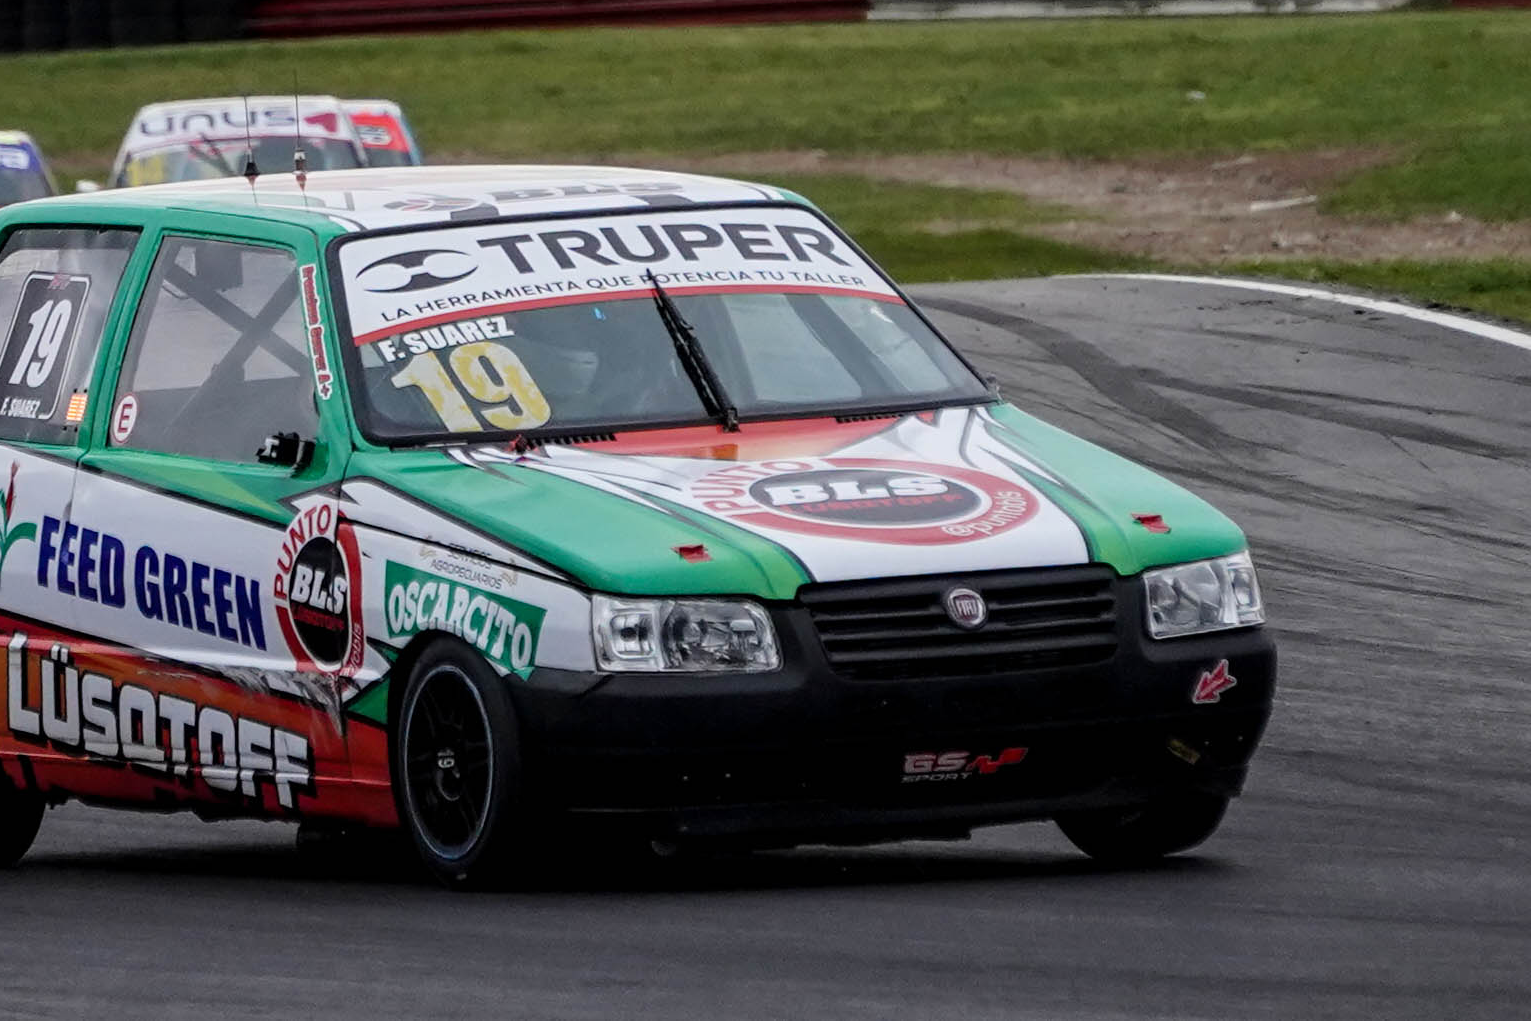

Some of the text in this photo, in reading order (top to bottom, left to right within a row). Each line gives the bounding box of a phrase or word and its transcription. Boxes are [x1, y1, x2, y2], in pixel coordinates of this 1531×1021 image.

[478, 223, 853, 274] TRUPER
[380, 269, 867, 322] LA HERRAMIENTA QUE POTENCIA TU TALLER
[8, 298, 73, 389] 19
[378, 316, 515, 363] F. SUAREZ
[390, 340, 552, 433] 19
[117, 403, 133, 434] E
[689, 460, 815, 513] PUNTO
[763, 477, 949, 507] BLS
[273, 503, 332, 600] PUNTO
[36, 514, 268, 652] FEED GREEN
[289, 563, 349, 615] BLS
[388, 580, 534, 671] OSCARCITO
